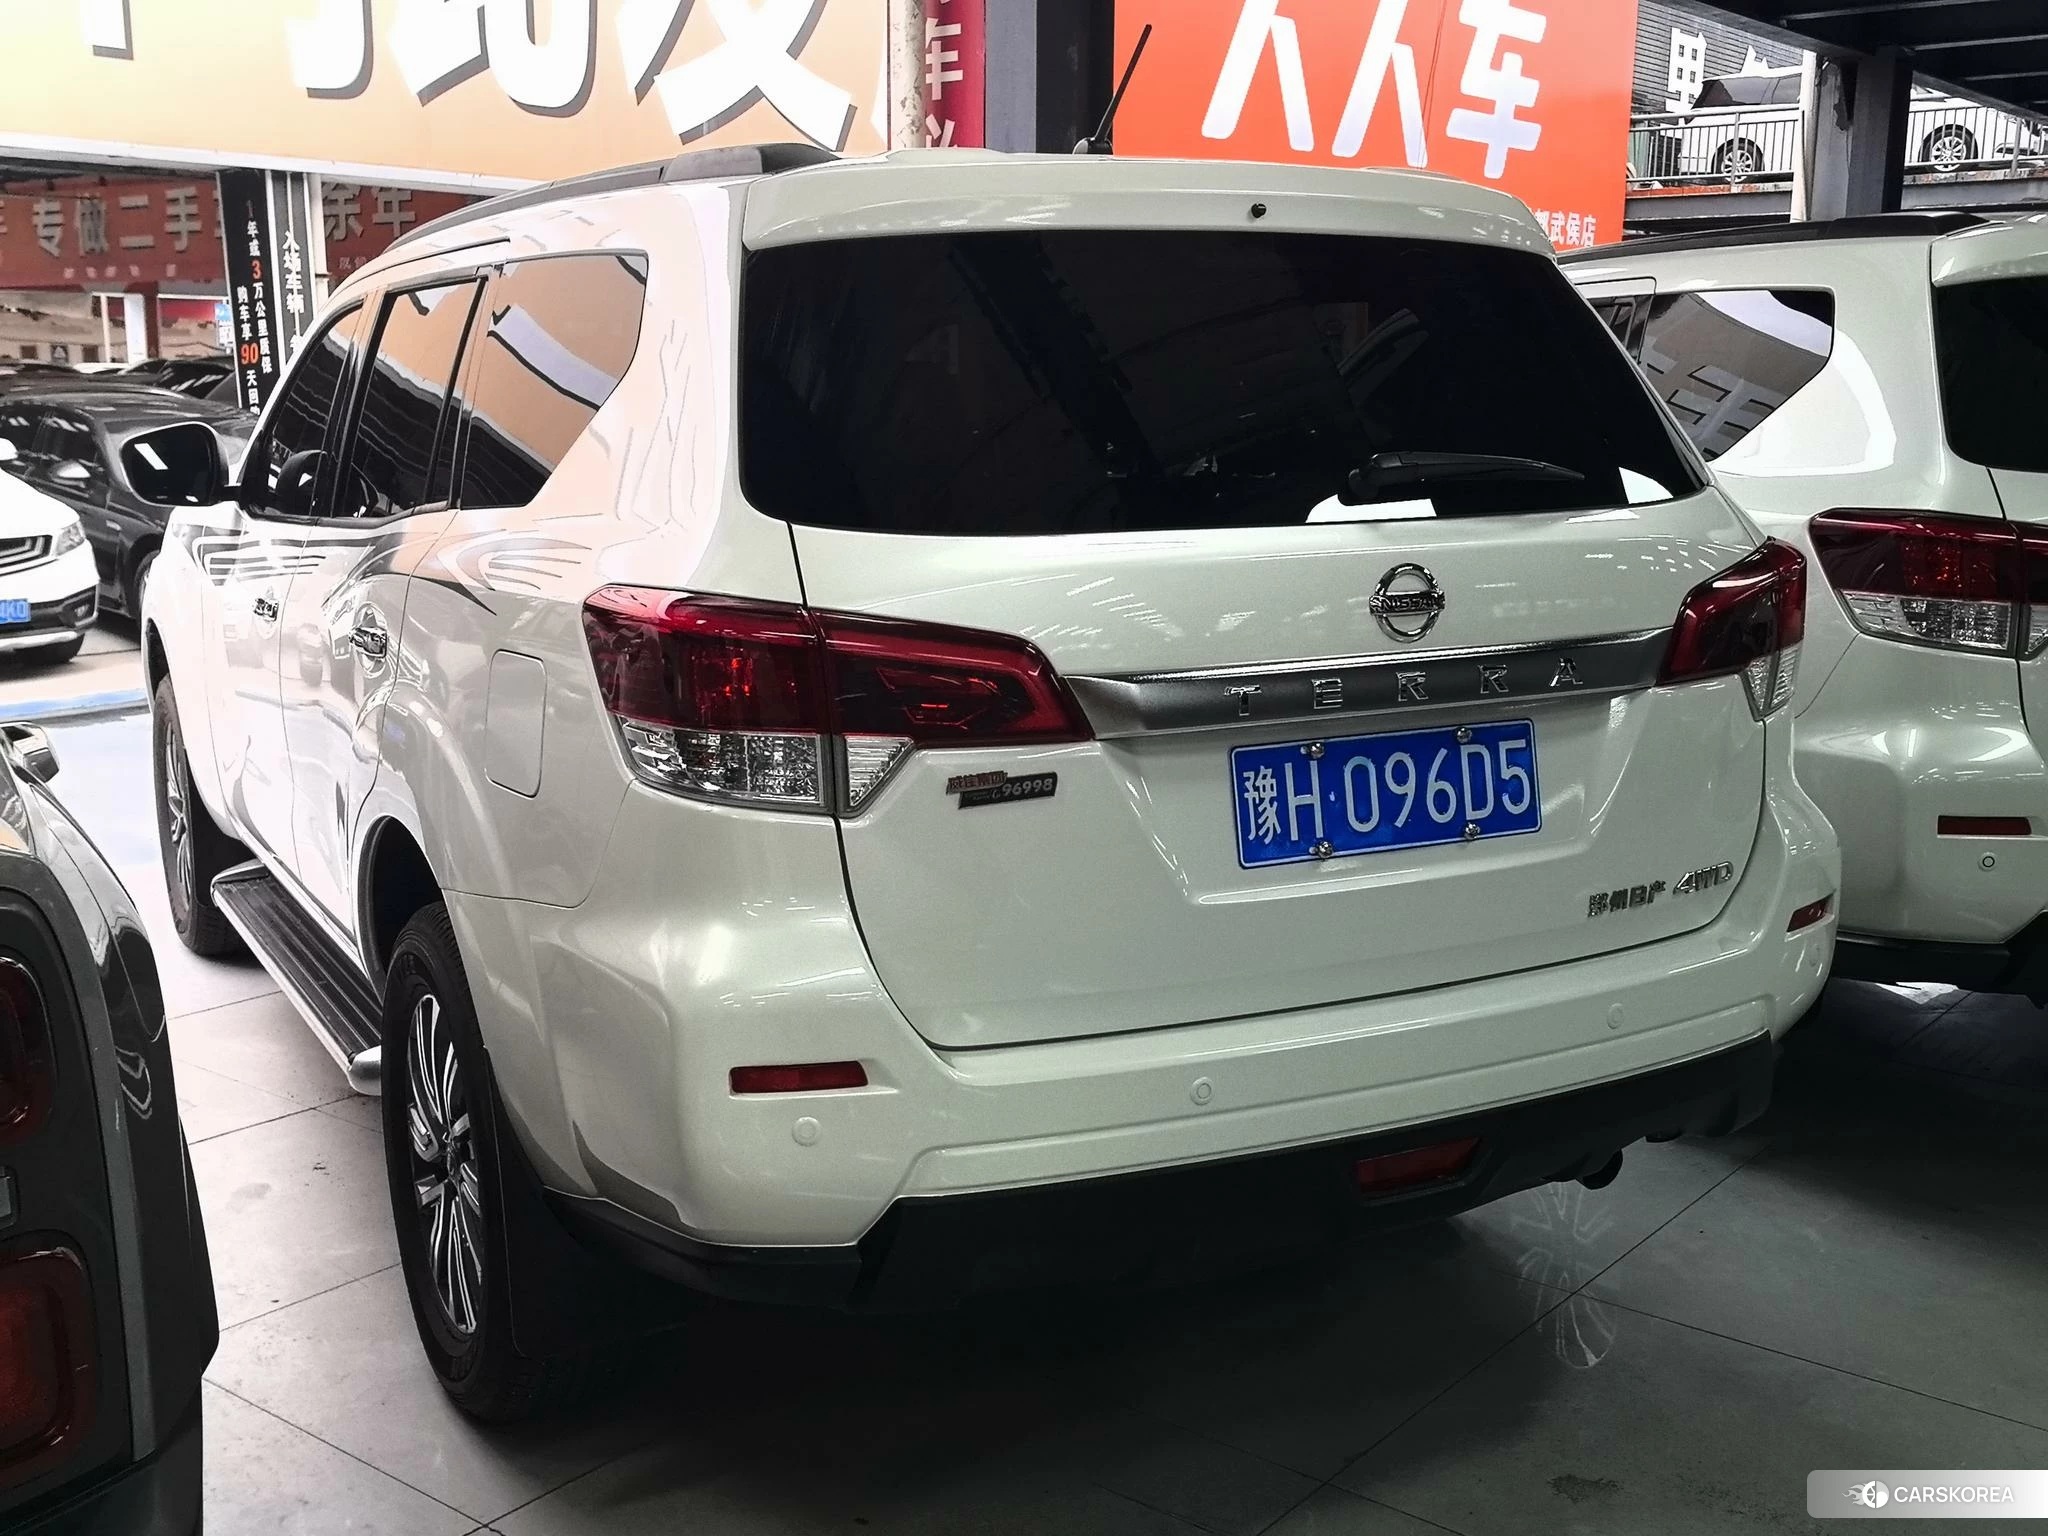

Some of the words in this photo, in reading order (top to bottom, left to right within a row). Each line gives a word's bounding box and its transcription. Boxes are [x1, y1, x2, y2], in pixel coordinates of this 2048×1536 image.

[1201, 0, 1547, 179] 人人车
[1223, 656, 1584, 717] TERRA
[1672, 860, 1735, 896] 4WD
